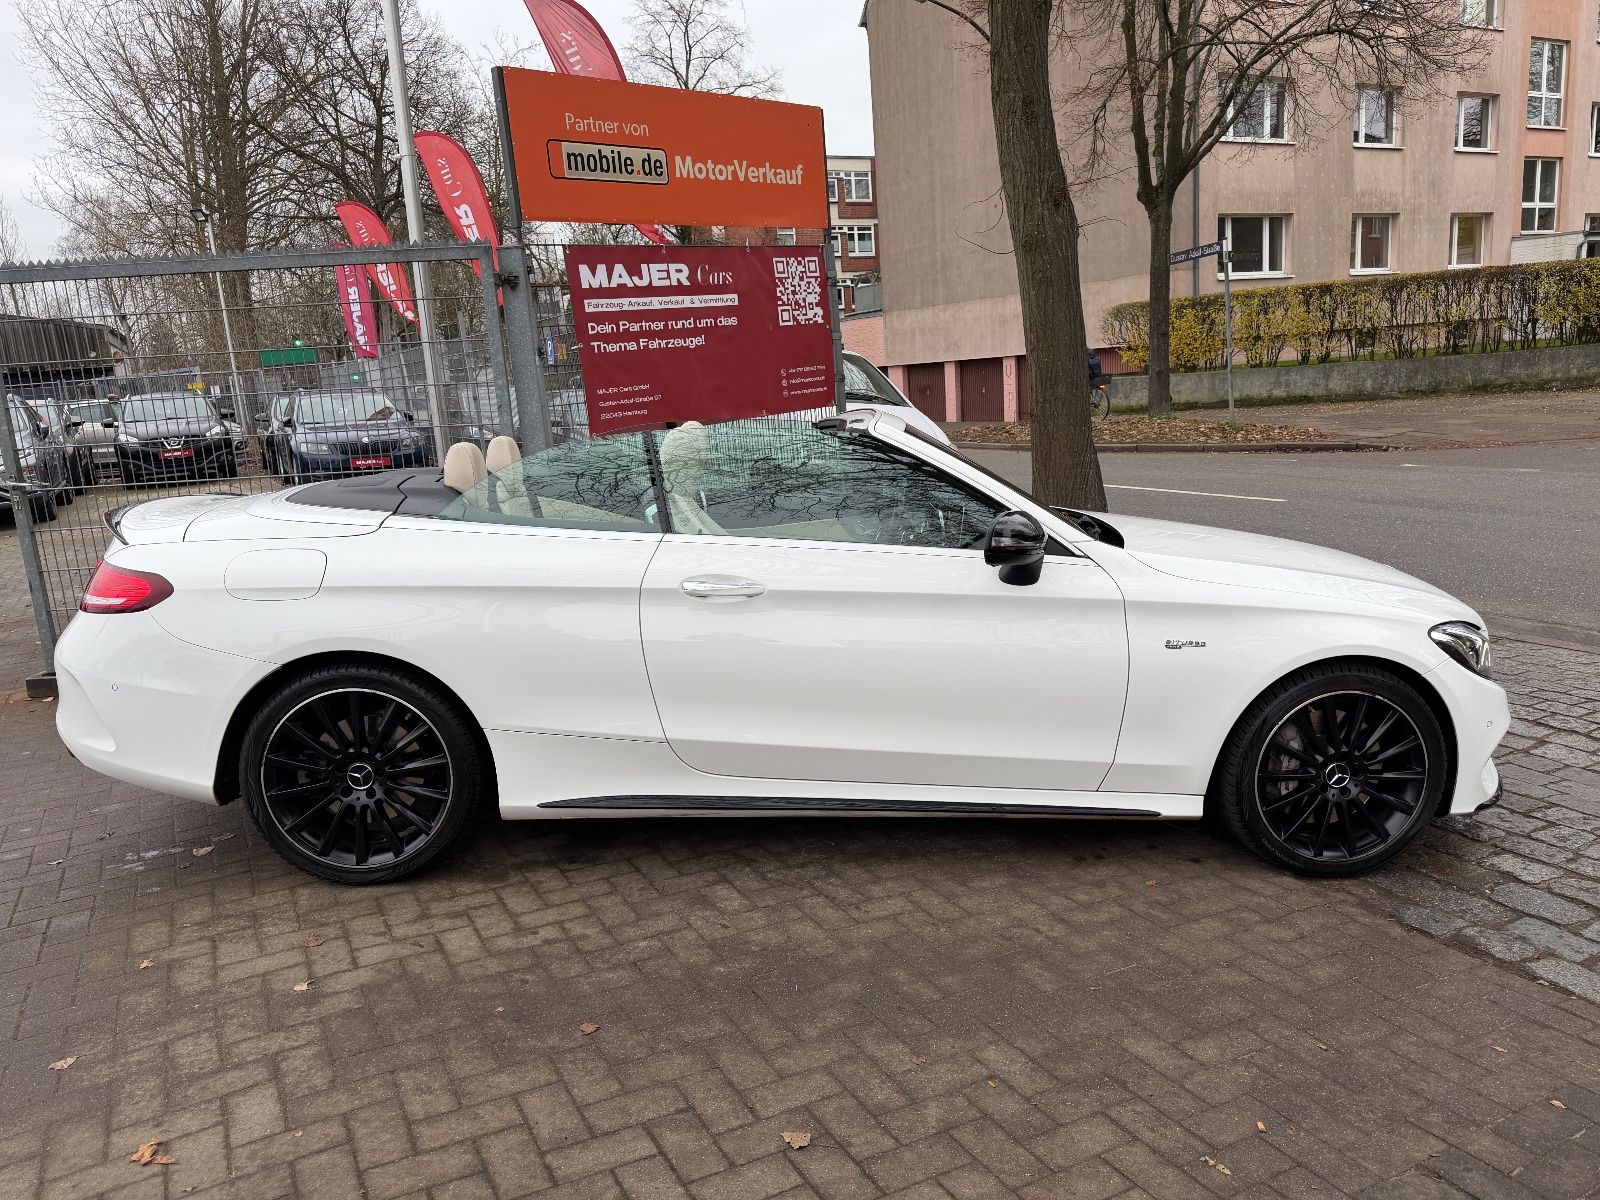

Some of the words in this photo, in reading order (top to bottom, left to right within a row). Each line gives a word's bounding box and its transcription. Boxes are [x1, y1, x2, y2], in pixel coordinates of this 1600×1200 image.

[565, 112, 619, 135] Partner
[622, 120, 649, 137] von
[566, 149, 664, 178] mobile.de
[674, 155, 803, 185] MotorVerkauf
[578, 263, 691, 289] MAJER
[697, 263, 734, 286] Cars
[657, 298, 685, 306] Verkauf
[698, 297, 736, 305] Vermittlung
[587, 322, 617, 335] Dein
[619, 319, 665, 332] Partner
[668, 317, 694, 329] rund
[696, 318, 715, 328] um
[716, 315, 738, 326] das
[590, 340, 638, 353] Thema
[639, 335, 706, 350] Fahrzeuge!
